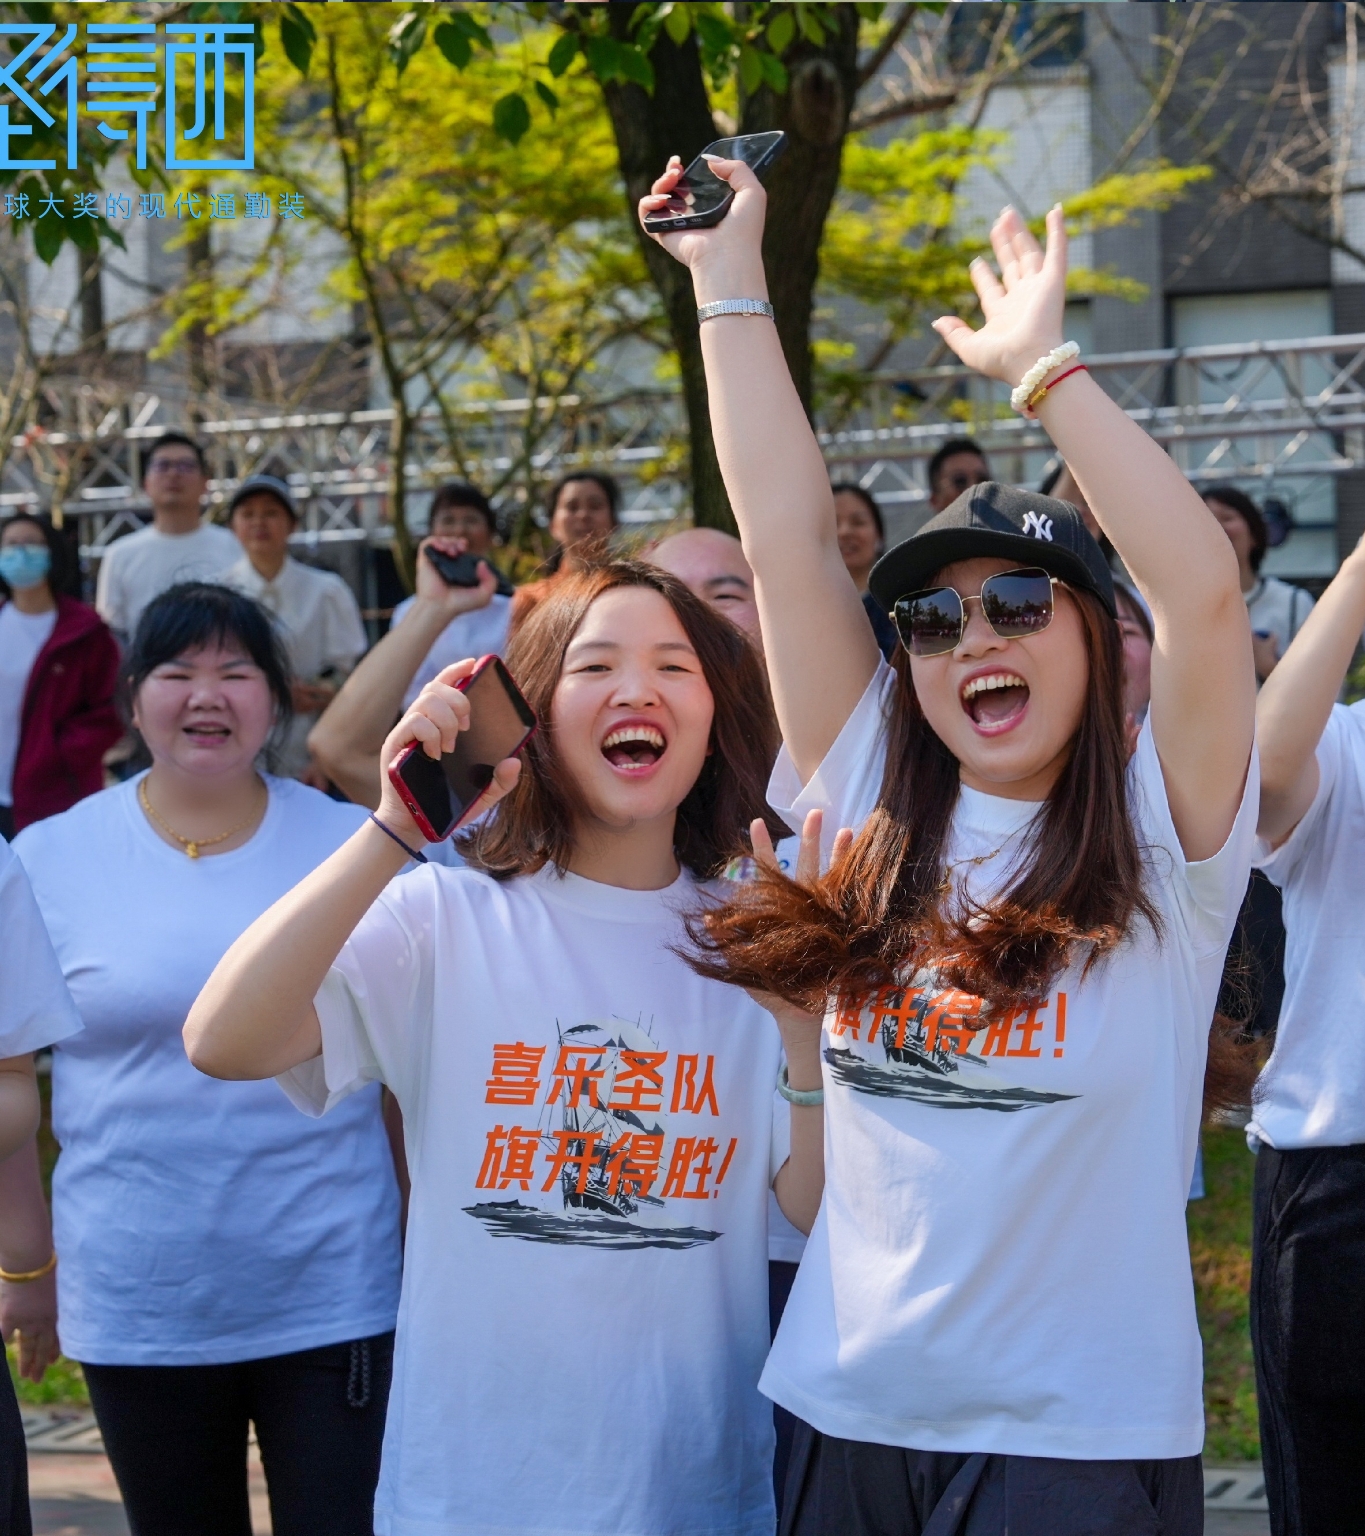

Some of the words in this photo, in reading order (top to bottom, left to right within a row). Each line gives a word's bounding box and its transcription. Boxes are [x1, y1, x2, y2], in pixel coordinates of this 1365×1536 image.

[484, 1041, 720, 1116] 喜乐圣队
[475, 1124, 740, 1199] 旗开得胜!
